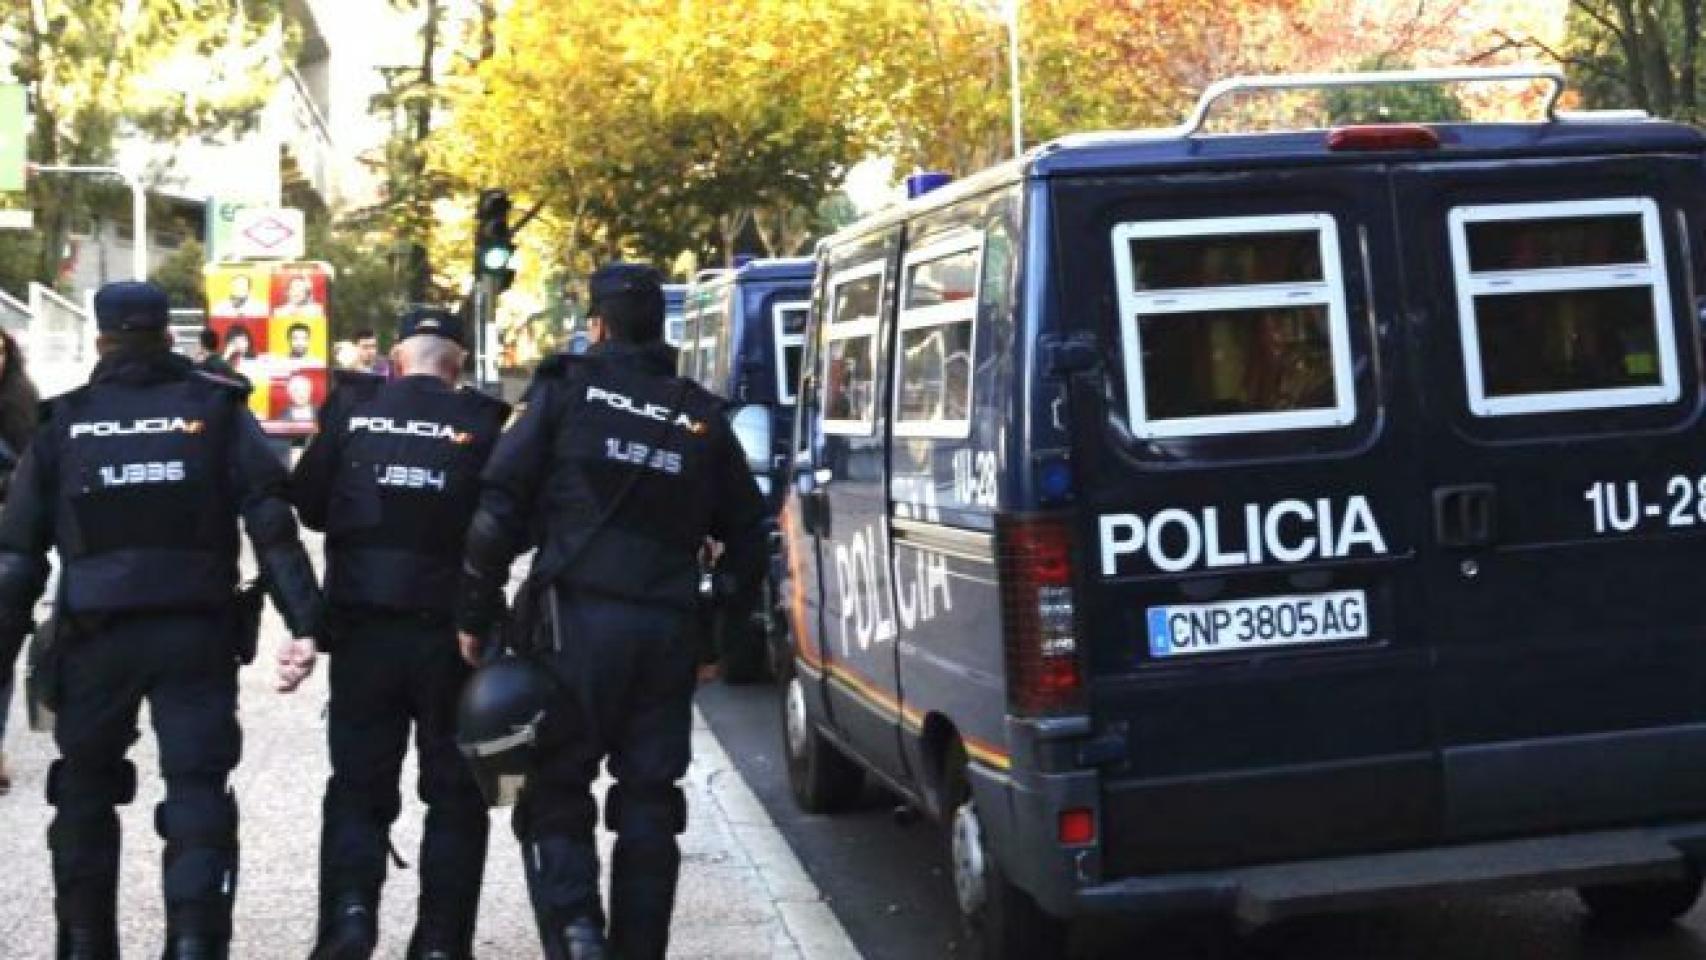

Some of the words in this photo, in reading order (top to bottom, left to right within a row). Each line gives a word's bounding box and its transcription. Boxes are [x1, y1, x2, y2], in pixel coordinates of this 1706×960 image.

[586, 387, 690, 430] POLICA
[69, 416, 186, 439] POLICIA
[349, 416, 457, 441] POLICIA
[1098, 494, 1389, 576] POLICIA
